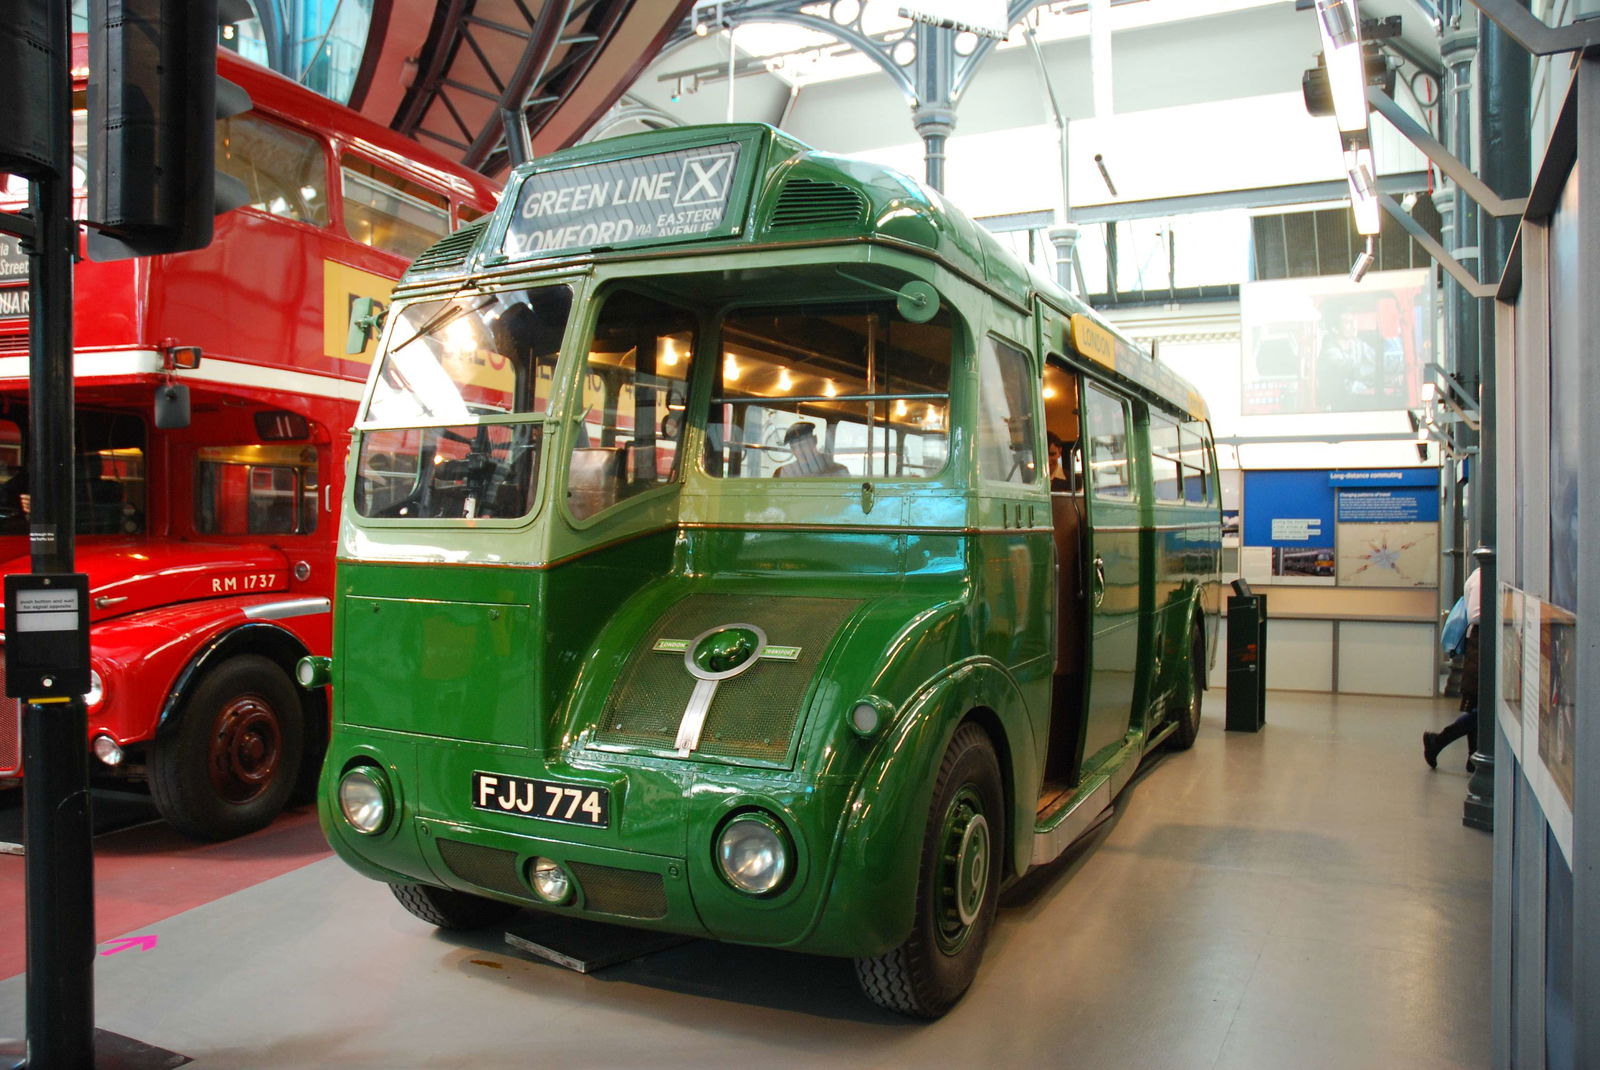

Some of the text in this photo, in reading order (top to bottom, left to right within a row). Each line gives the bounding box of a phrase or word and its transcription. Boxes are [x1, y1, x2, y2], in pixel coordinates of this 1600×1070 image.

[522, 157, 728, 219] GREEN LINE X
[656, 207, 722, 228] EASTERN
[635, 223, 654, 237] VIA
[0, 259, 29, 276] Street
[276, 415, 292, 437] 11
[212, 574, 276, 593] RM 1737
[479, 775, 602, 823] FJJ 774
